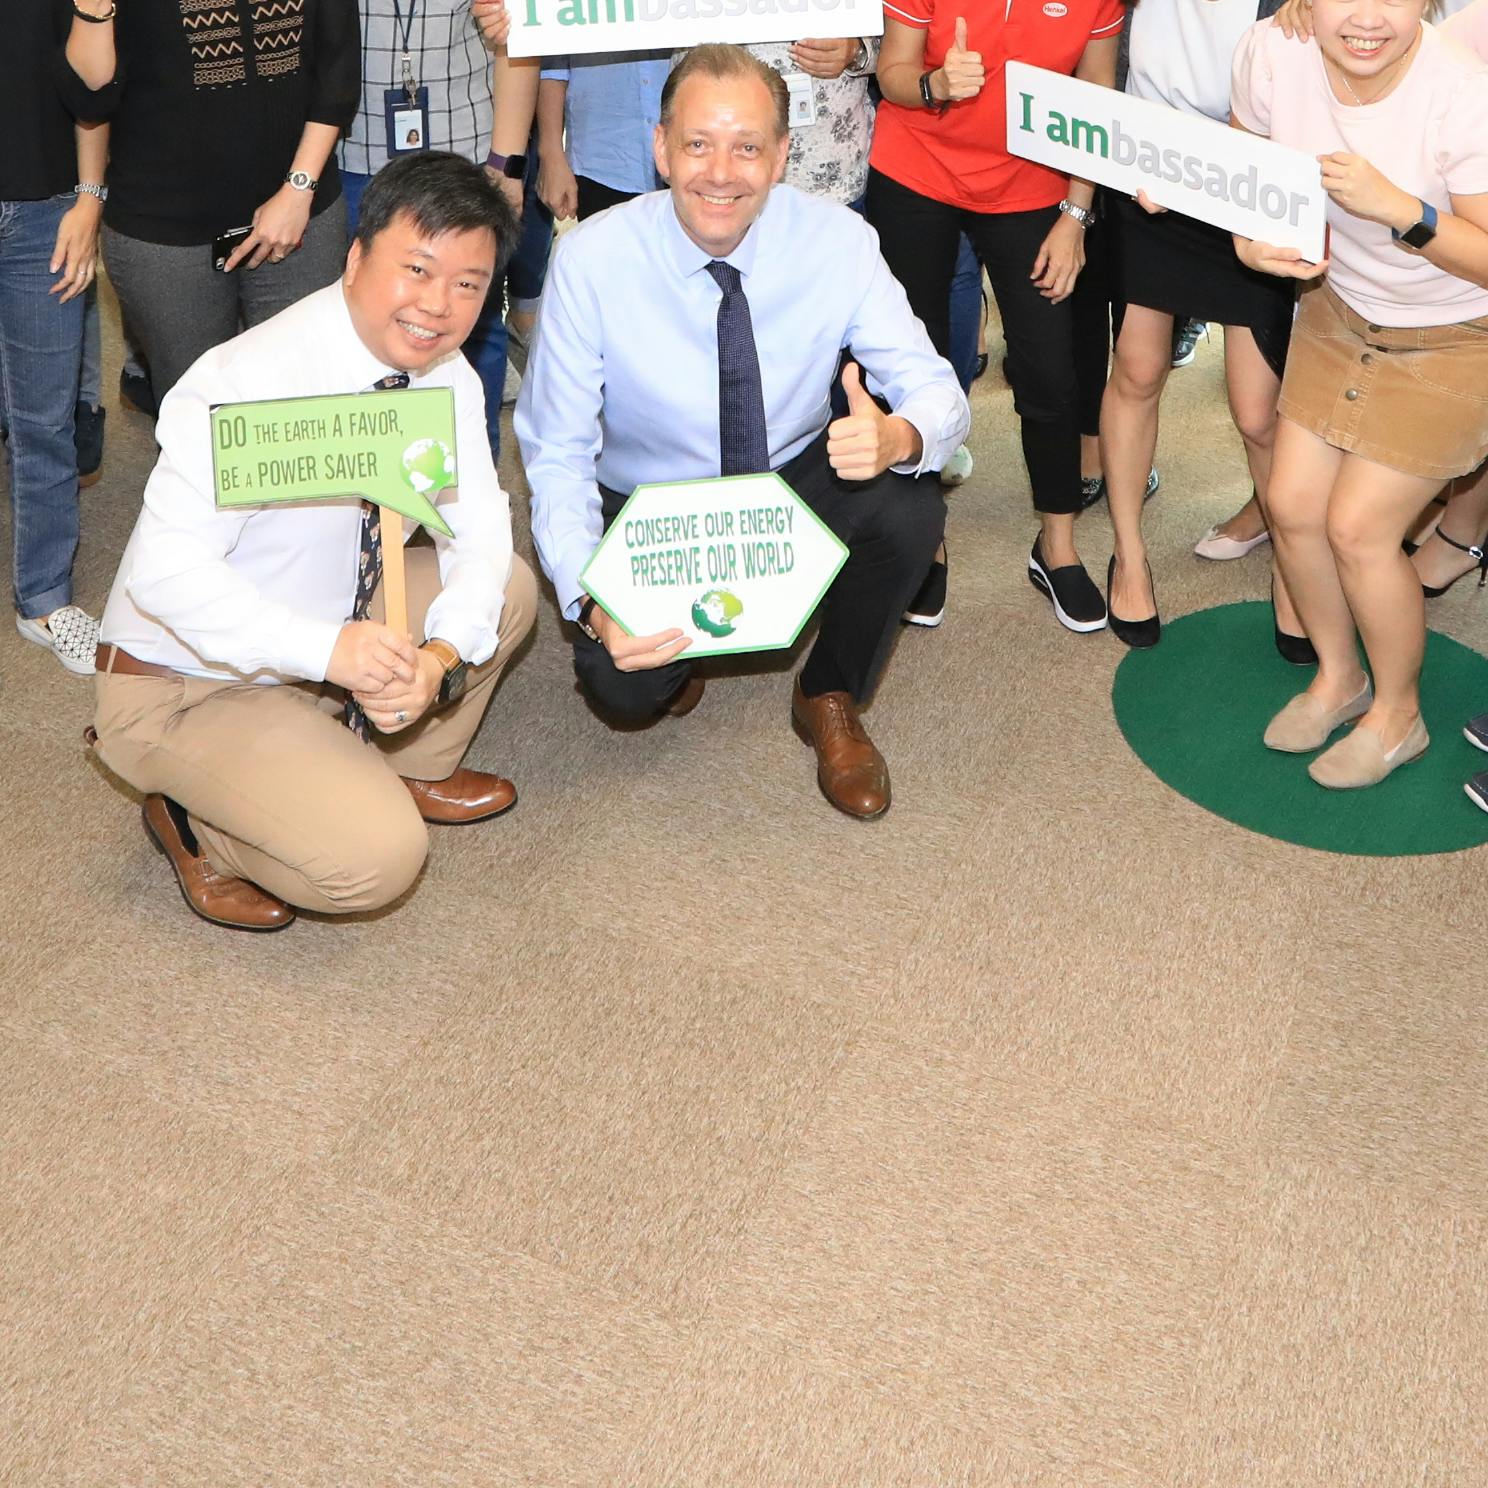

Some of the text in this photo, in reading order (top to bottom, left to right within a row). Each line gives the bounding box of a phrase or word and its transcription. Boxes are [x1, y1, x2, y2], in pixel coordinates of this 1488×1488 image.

[1018, 91, 1310, 227] I ambassador
[219, 415, 247, 450] DO
[285, 418, 327, 442] EARTH
[332, 414, 342, 438] A
[350, 409, 404, 438] FAVOR,
[221, 452, 378, 491] BE A POWER SAVER
[625, 505, 794, 548] CONSERVE OUR ENERGY
[630, 541, 794, 587] PRESERVE OUR WORLD
